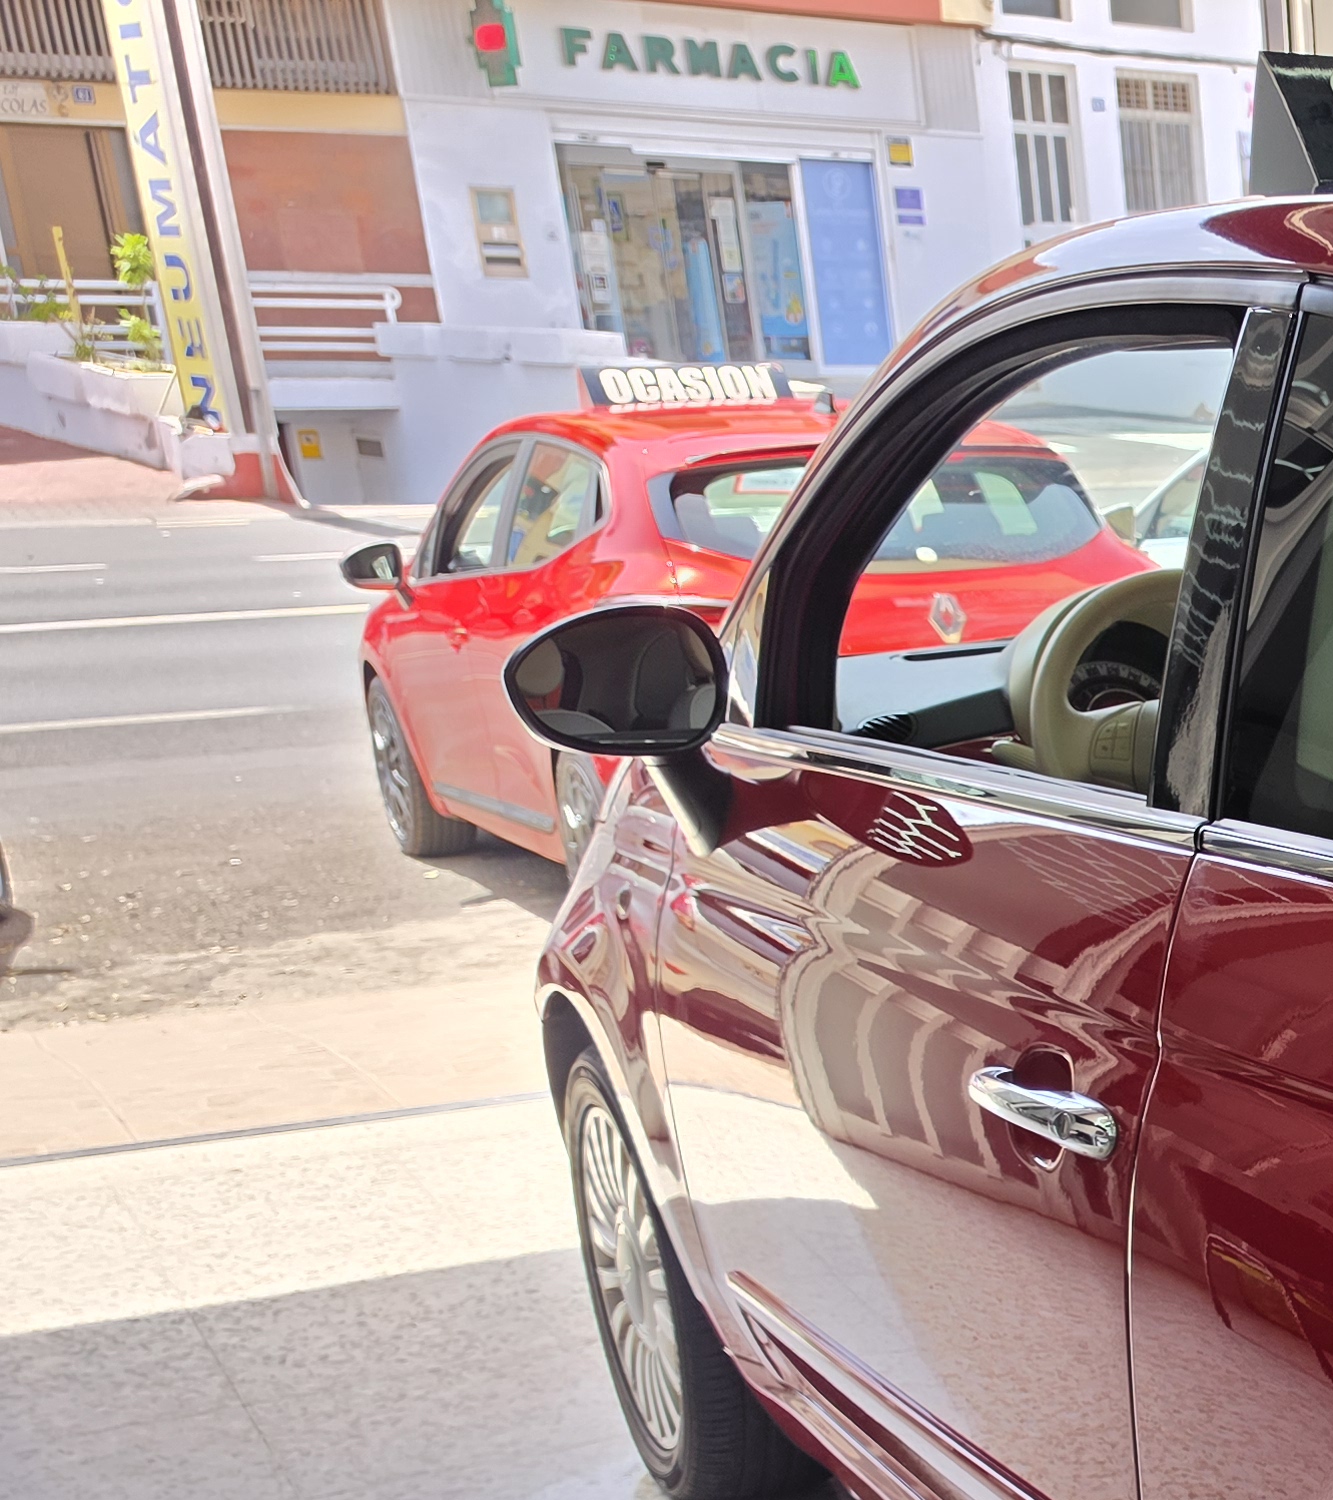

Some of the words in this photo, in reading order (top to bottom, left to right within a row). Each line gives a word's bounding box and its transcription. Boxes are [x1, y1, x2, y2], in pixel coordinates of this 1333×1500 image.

[560, 27, 861, 89] FARMACIA
[117, 0, 224, 431] NEUMÁTI
[600, 366, 778, 404] OCASION
